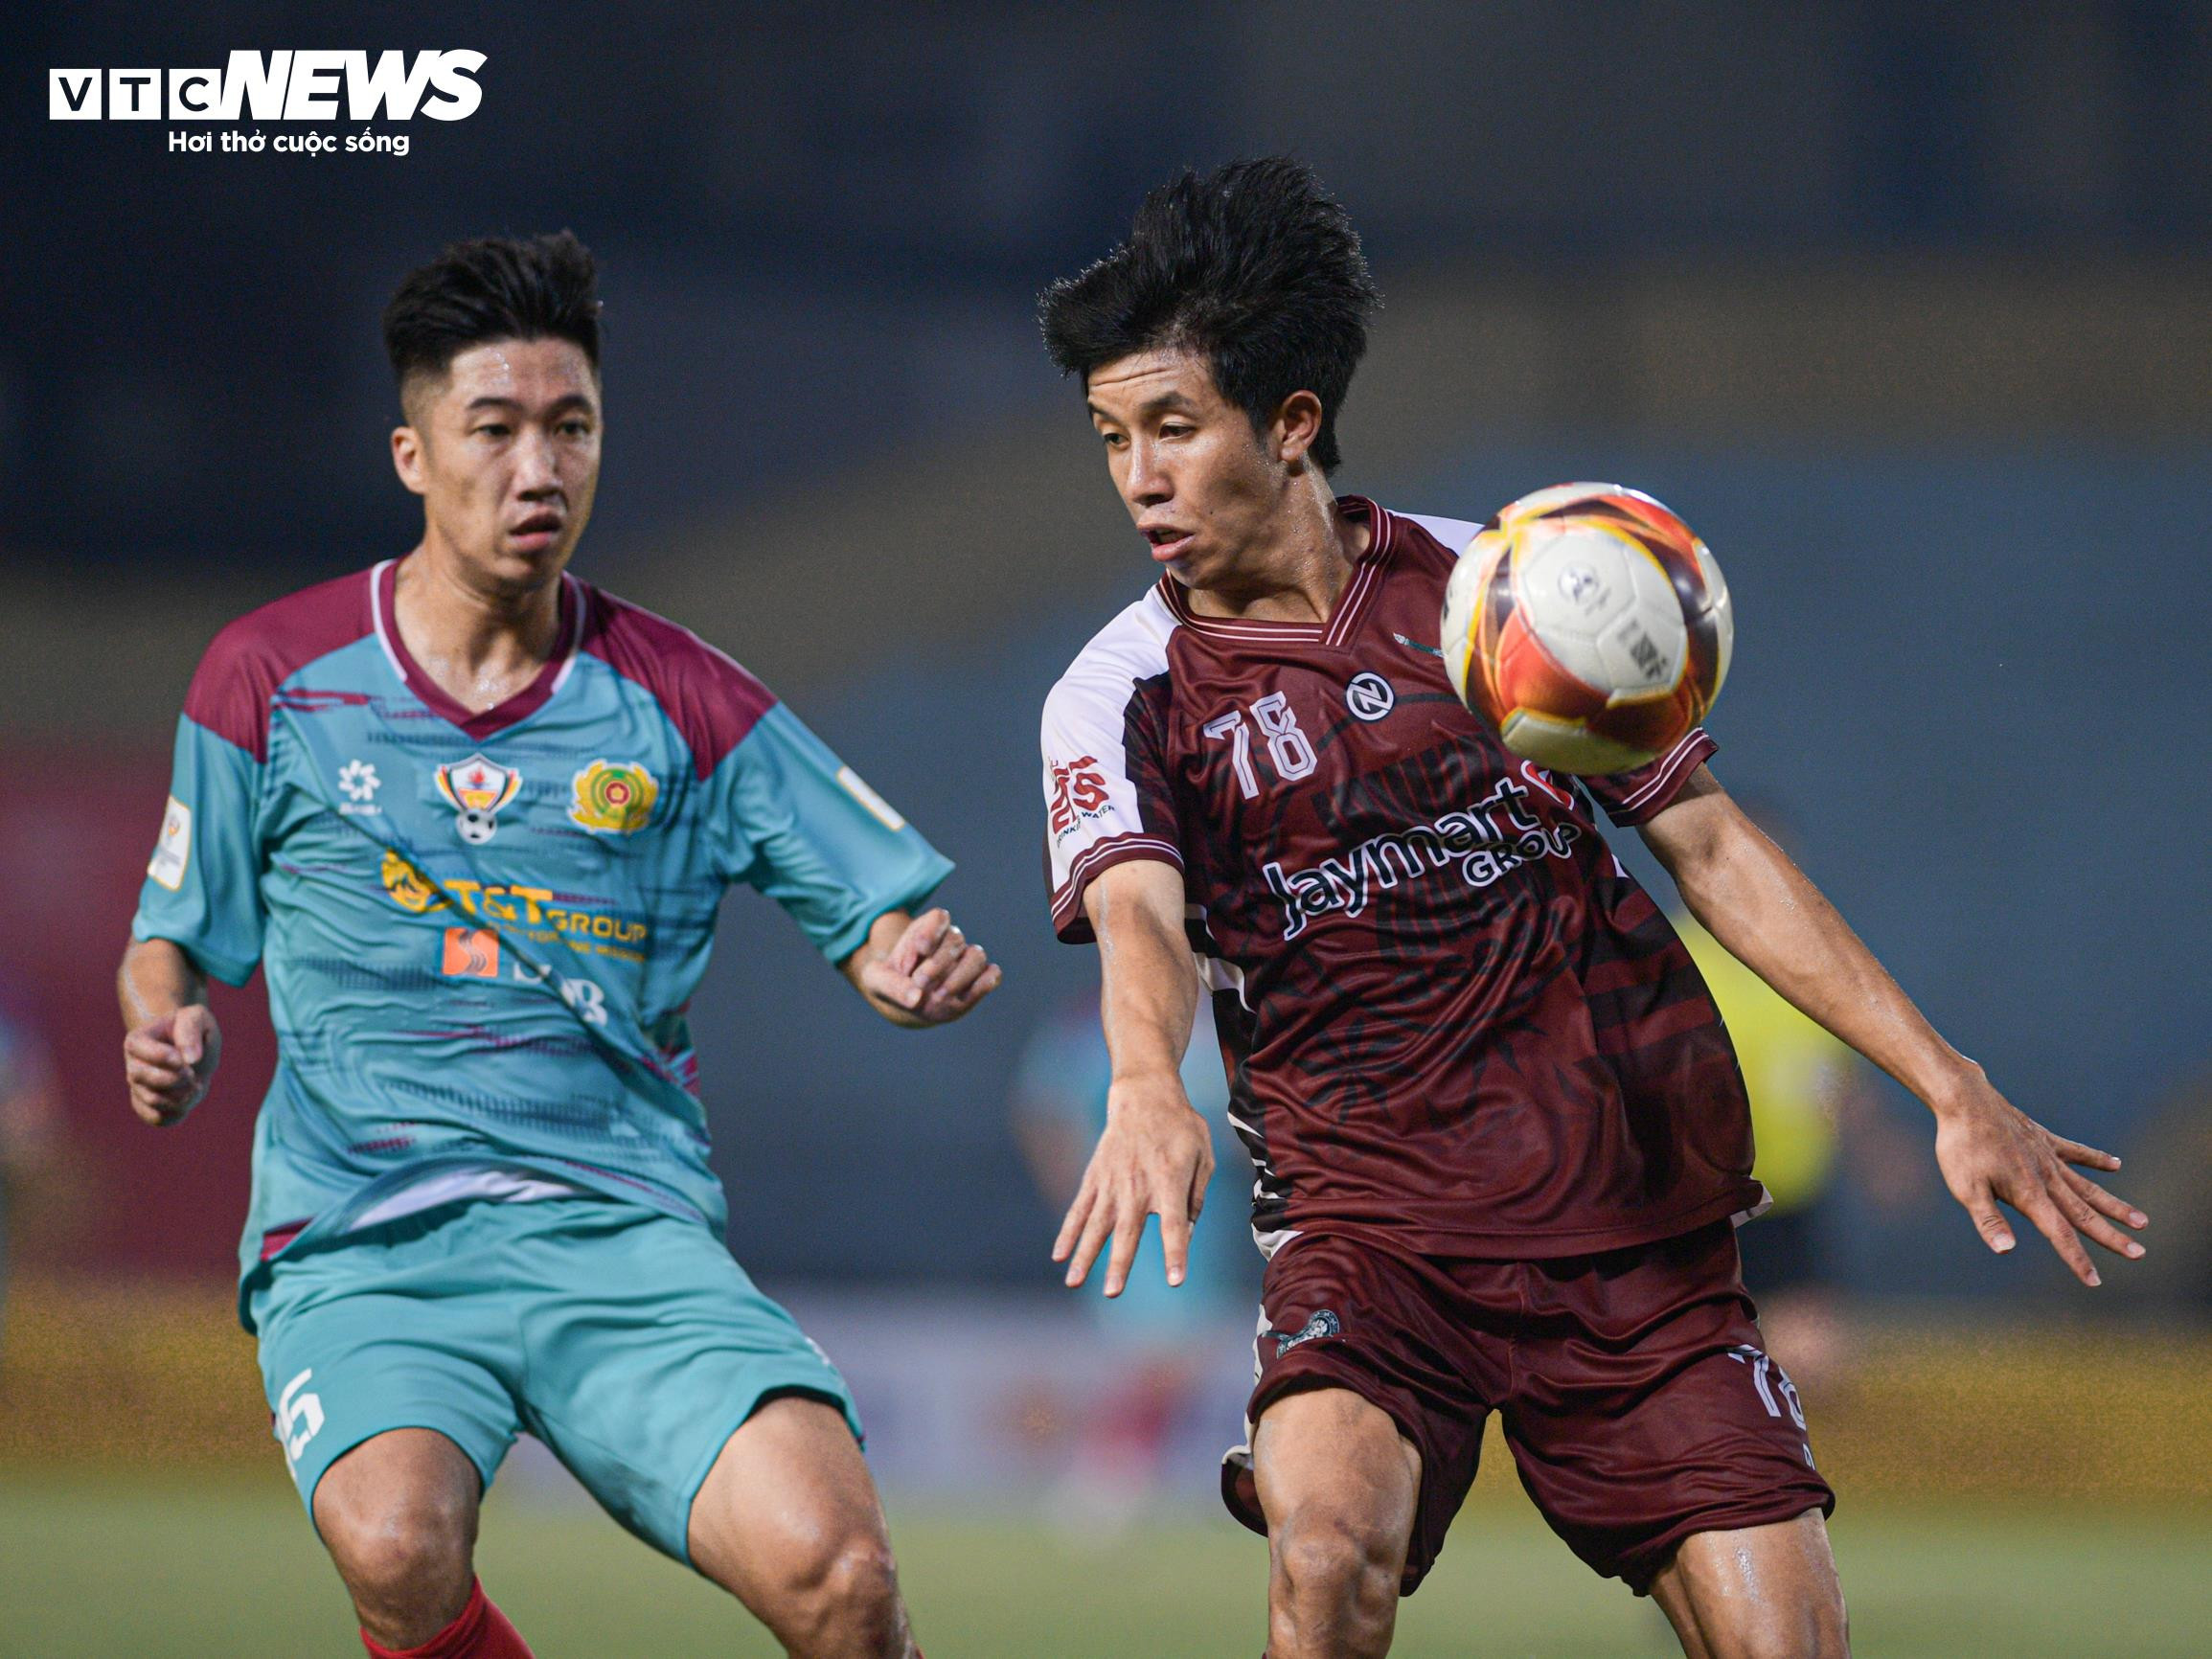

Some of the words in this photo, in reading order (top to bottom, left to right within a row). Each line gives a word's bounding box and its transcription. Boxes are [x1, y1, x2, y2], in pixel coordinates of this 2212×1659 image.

[1203, 691, 1317, 800] 78
[1263, 776, 1541, 942] Jaymart
[1462, 822, 1582, 887] GROUP
[547, 909, 648, 943] GROUP
